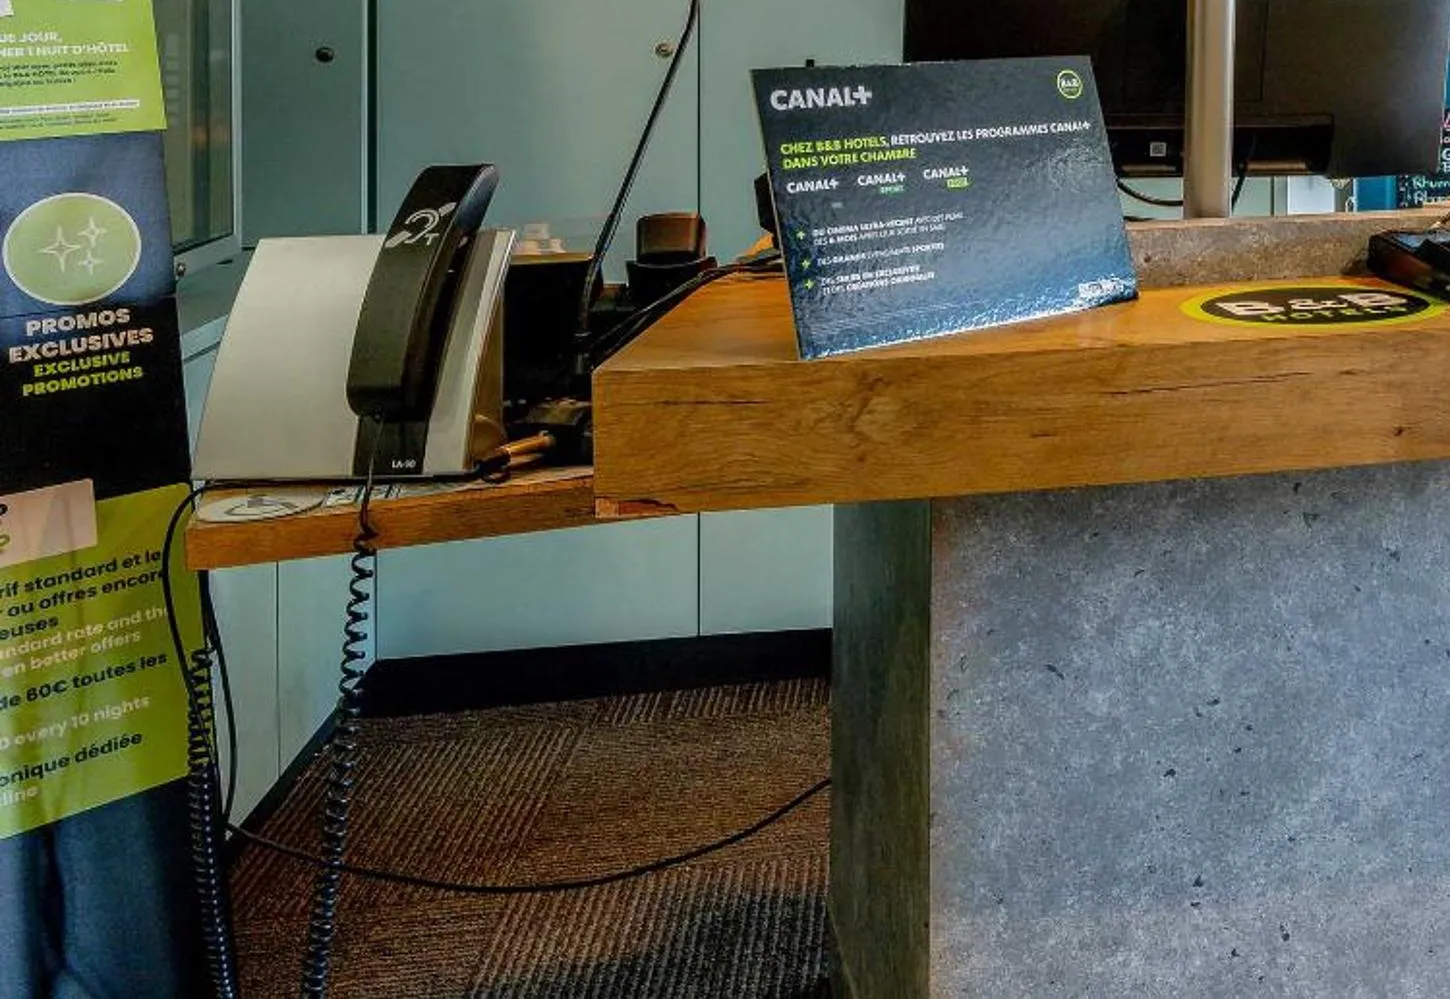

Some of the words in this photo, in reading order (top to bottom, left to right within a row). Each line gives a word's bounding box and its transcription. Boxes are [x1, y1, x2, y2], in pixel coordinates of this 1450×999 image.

[770, 85, 873, 111] CANAL+
[780, 142, 814, 155] CHEZ
[815, 139, 842, 152] B&B
[890, 130, 956, 146] RETROUVEZ
[975, 123, 1049, 139] PROGRAMMES
[1049, 120, 1092, 133] CANAL+
[783, 155, 819, 169] DANS
[820, 152, 859, 166] VOTRE
[859, 148, 917, 163] CHAMBRE
[922, 165, 970, 180] CANAL+
[786, 178, 840, 194] CANAL+
[857, 172, 907, 186] CANAL+
[1215, 292, 1408, 316] B&B
[26, 308, 131, 336] PROMOS
[8, 327, 154, 364] EXCLUSIVES
[33, 351, 131, 377] EXCLUSIVE
[22, 366, 144, 396] PROMOTIONS
[24, 557, 118, 593] standard
[121, 553, 142, 569] et
[39, 585, 97, 610] offres
[101, 570, 166, 594] encor
[0, 616, 59, 640] euses
[67, 621, 104, 642] rate
[107, 608, 143, 631] and
[146, 606, 168, 621] th
[30, 646, 86, 671] better
[90, 630, 142, 654] offers
[72, 660, 137, 689] toutes
[140, 653, 169, 670] les
[14, 721, 68, 746] every
[71, 712, 91, 730] 10
[93, 695, 151, 722] nights
[75, 732, 143, 764] dédiée
